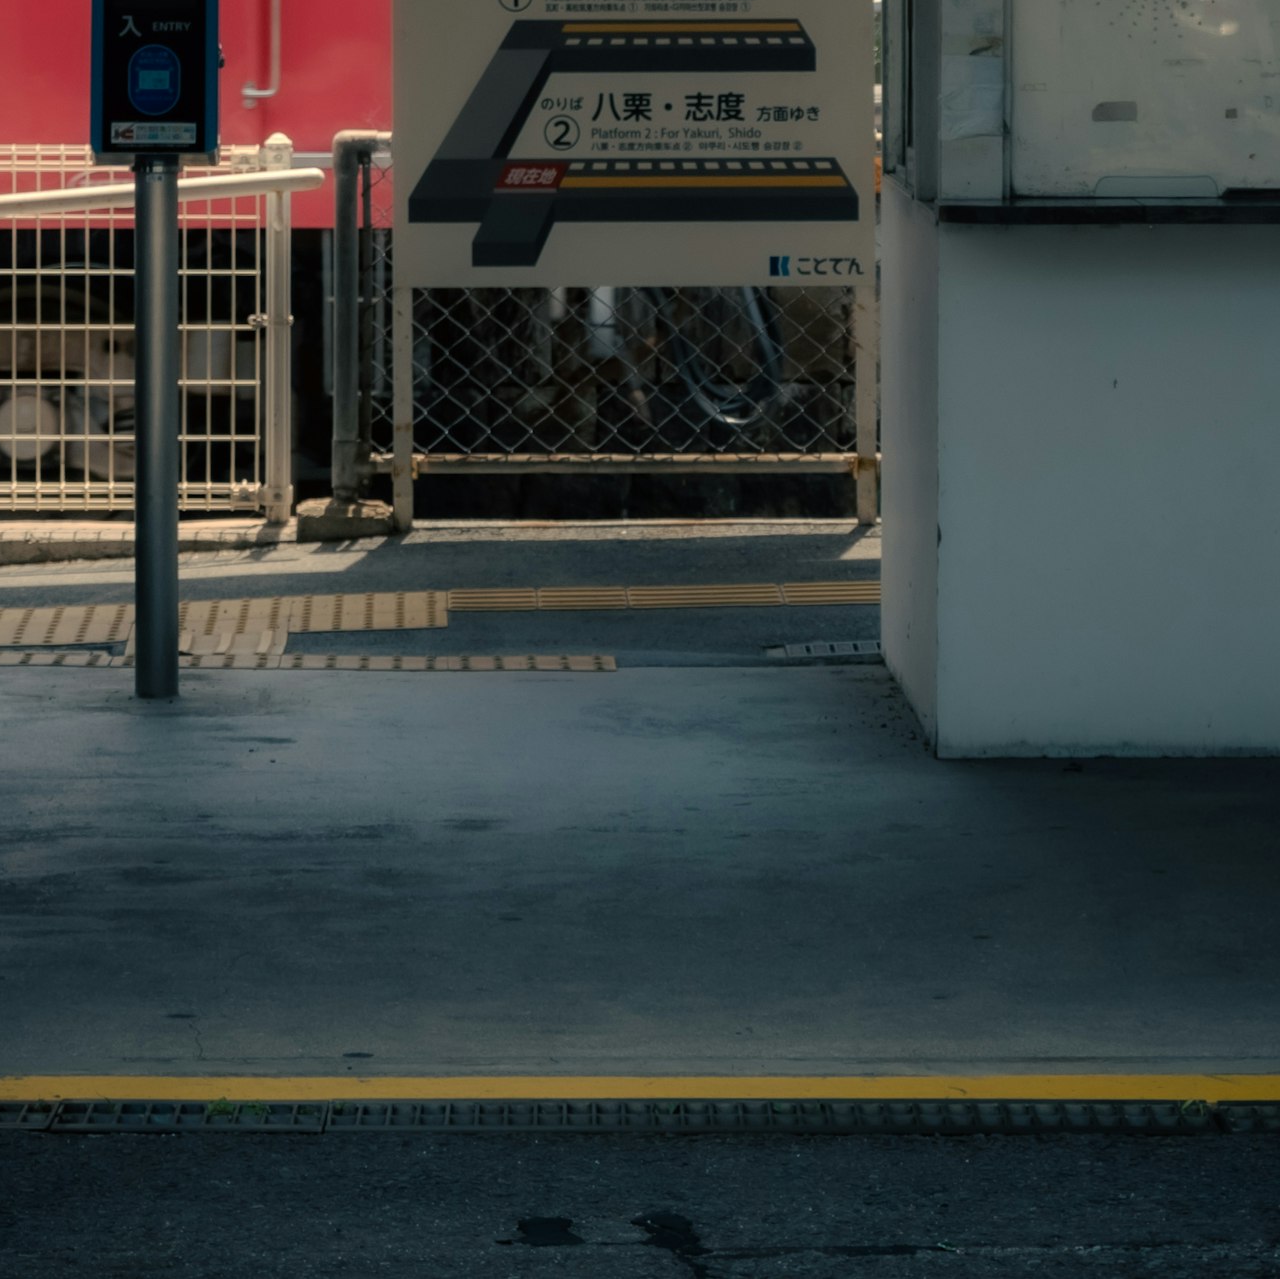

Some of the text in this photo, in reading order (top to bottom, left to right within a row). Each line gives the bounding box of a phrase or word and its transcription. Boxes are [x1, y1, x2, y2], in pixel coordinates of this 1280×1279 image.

[118, 15, 192, 38] 入 ENTRY
[540, 96, 584, 112] のりば
[591, 91, 821, 123] 八栗・志度 方面ゆき
[591, 128, 642, 139] Platform
[660, 128, 679, 139] For
[683, 128, 722, 141] Yakuri,
[728, 128, 762, 139] Shido
[504, 167, 557, 186] 現在地
[796, 256, 865, 277] ことでん
